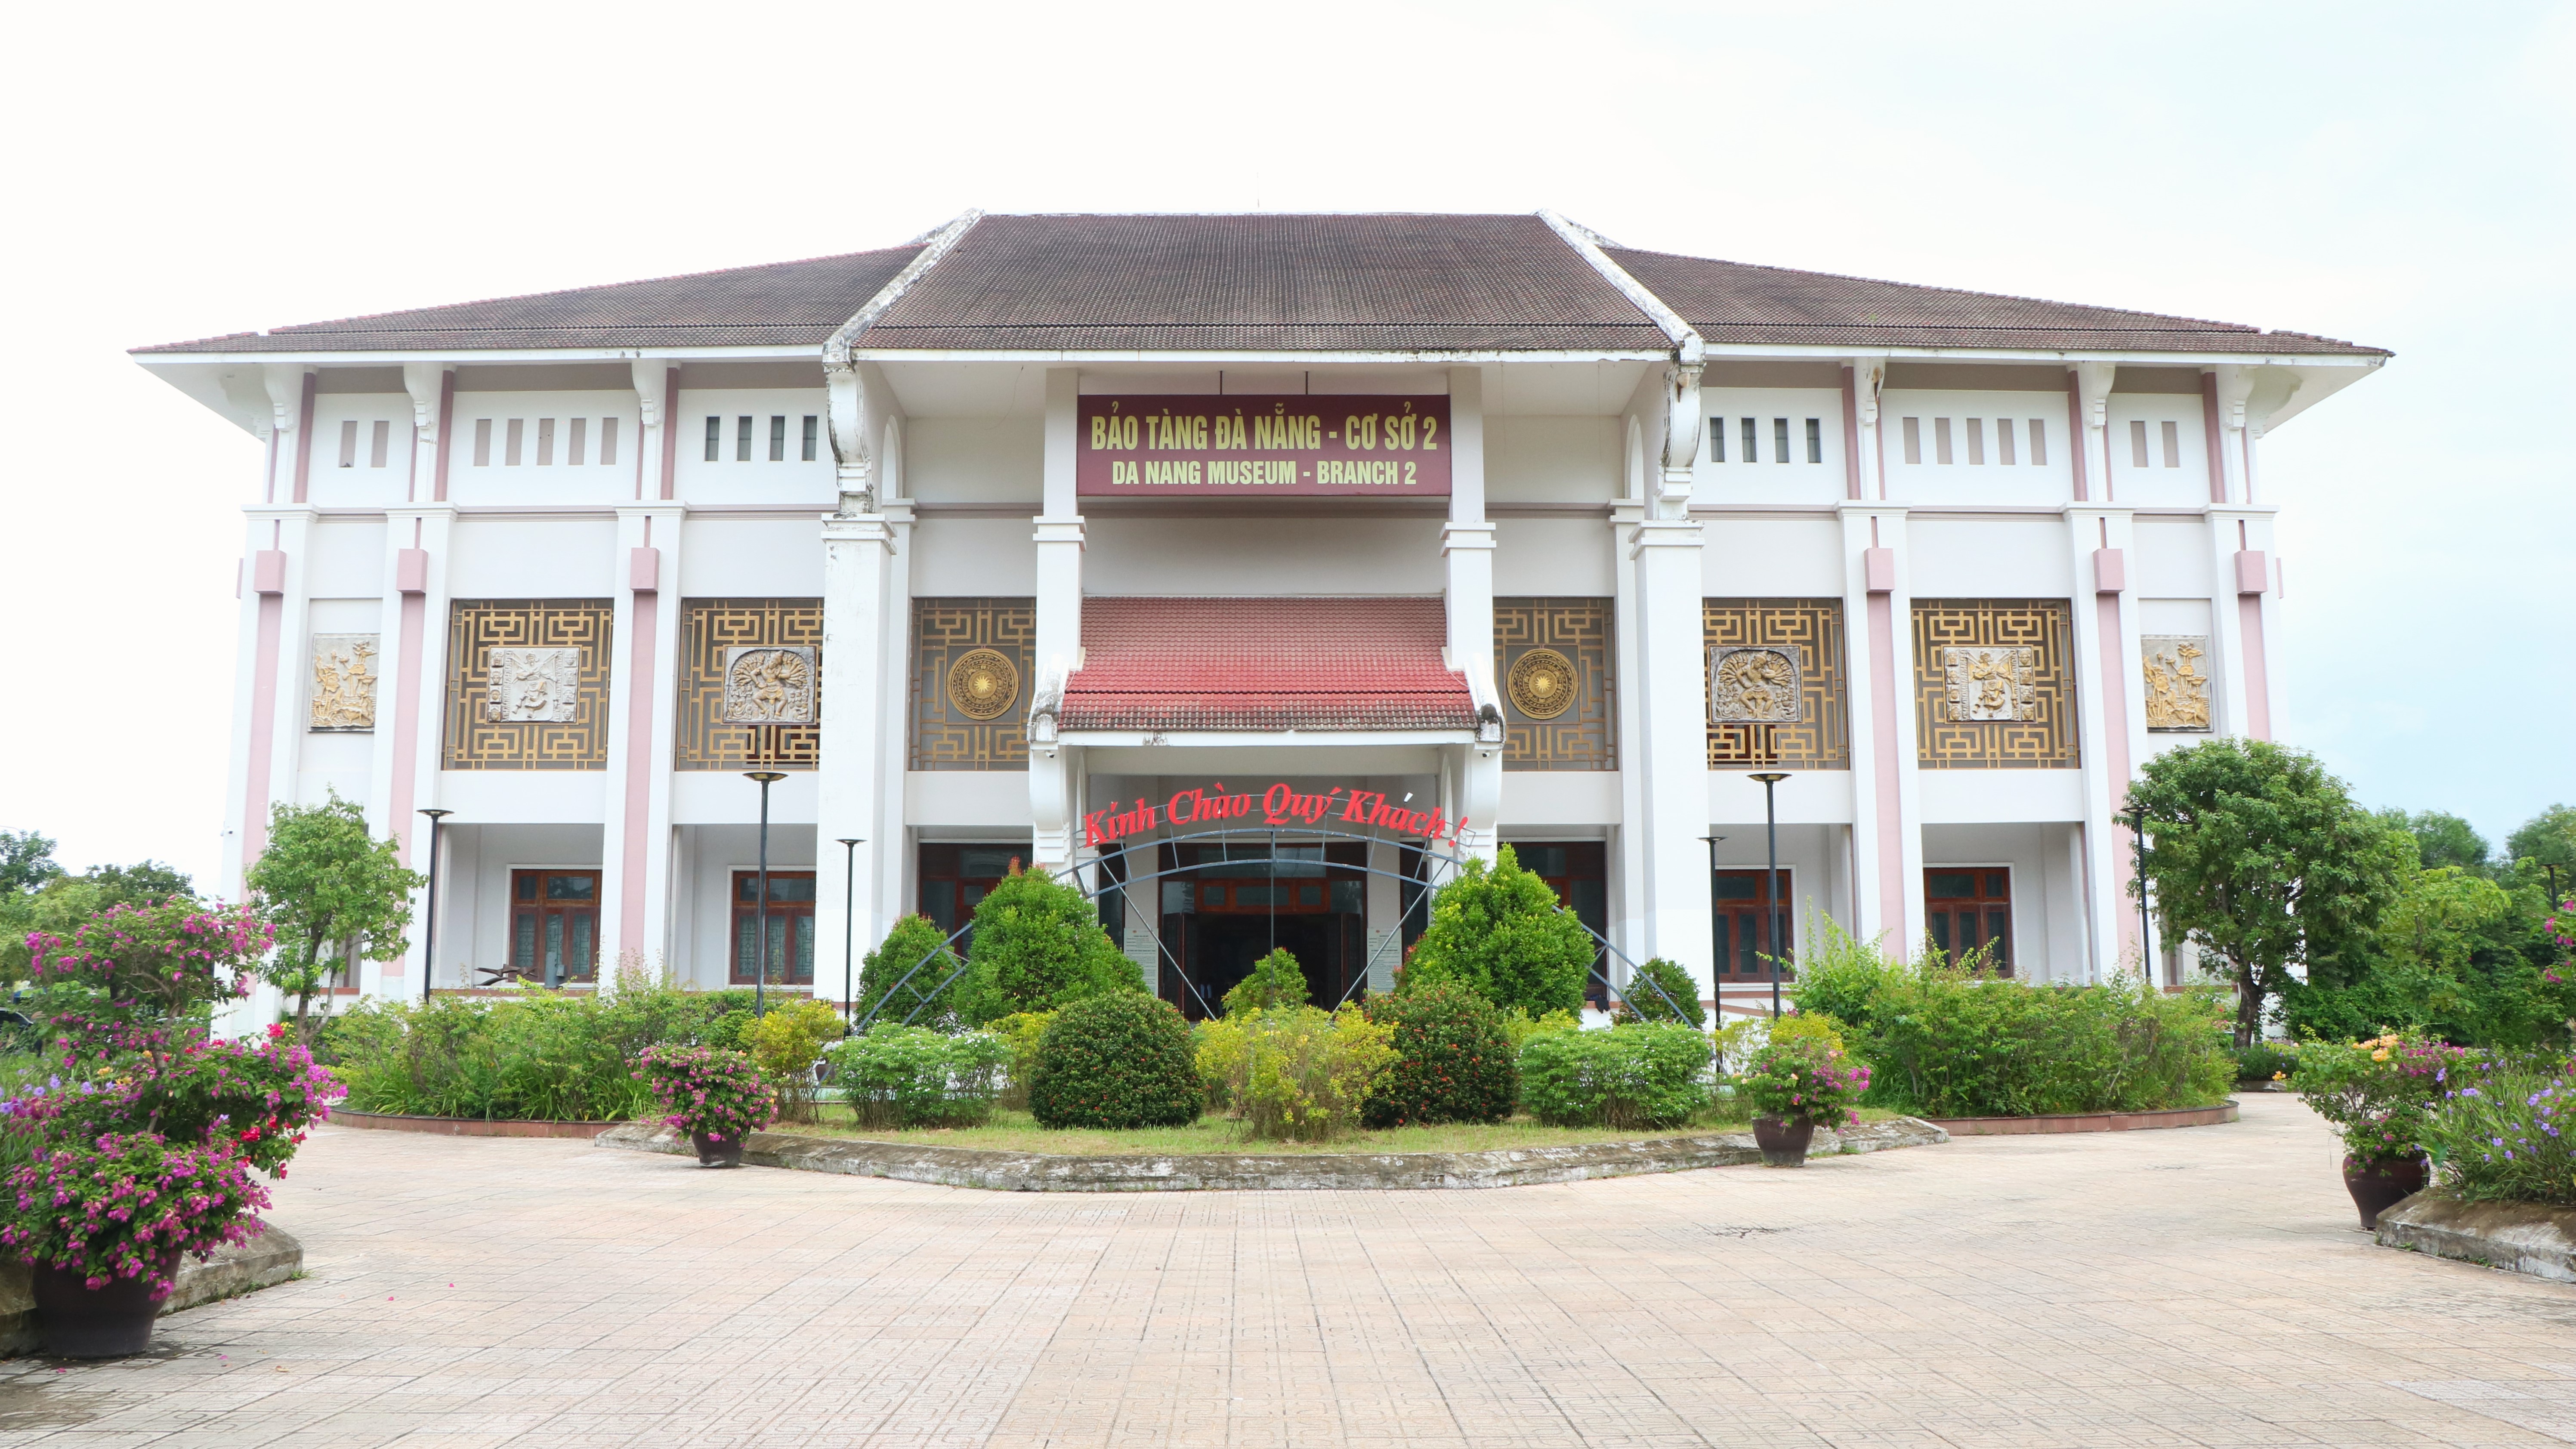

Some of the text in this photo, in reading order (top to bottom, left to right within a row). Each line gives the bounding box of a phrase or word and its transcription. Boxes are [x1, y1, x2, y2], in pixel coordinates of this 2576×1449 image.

[1091, 401, 1138, 450] BẢO
[1146, 408, 1207, 450] TÀNG
[1215, 408, 1247, 450] ĐÀ
[1254, 403, 1320, 450] NẴNG
[1346, 414, 1378, 450] CƠ
[1384, 401, 1416, 450] SỞ
[1423, 416, 1437, 450] 2
[1112, 460, 1139, 484] DA
[1145, 460, 1201, 484] NANG
[1208, 460, 1297, 484] MUSEUM
[1317, 460, 1398, 484] BRANCH
[1405, 460, 1417, 485] 2
[1083, 798, 1156, 848] Kính
[1167, 782, 1251, 825] Chào
[1263, 783, 1342, 825] Quý
[1339, 789, 1446, 840] Khách
